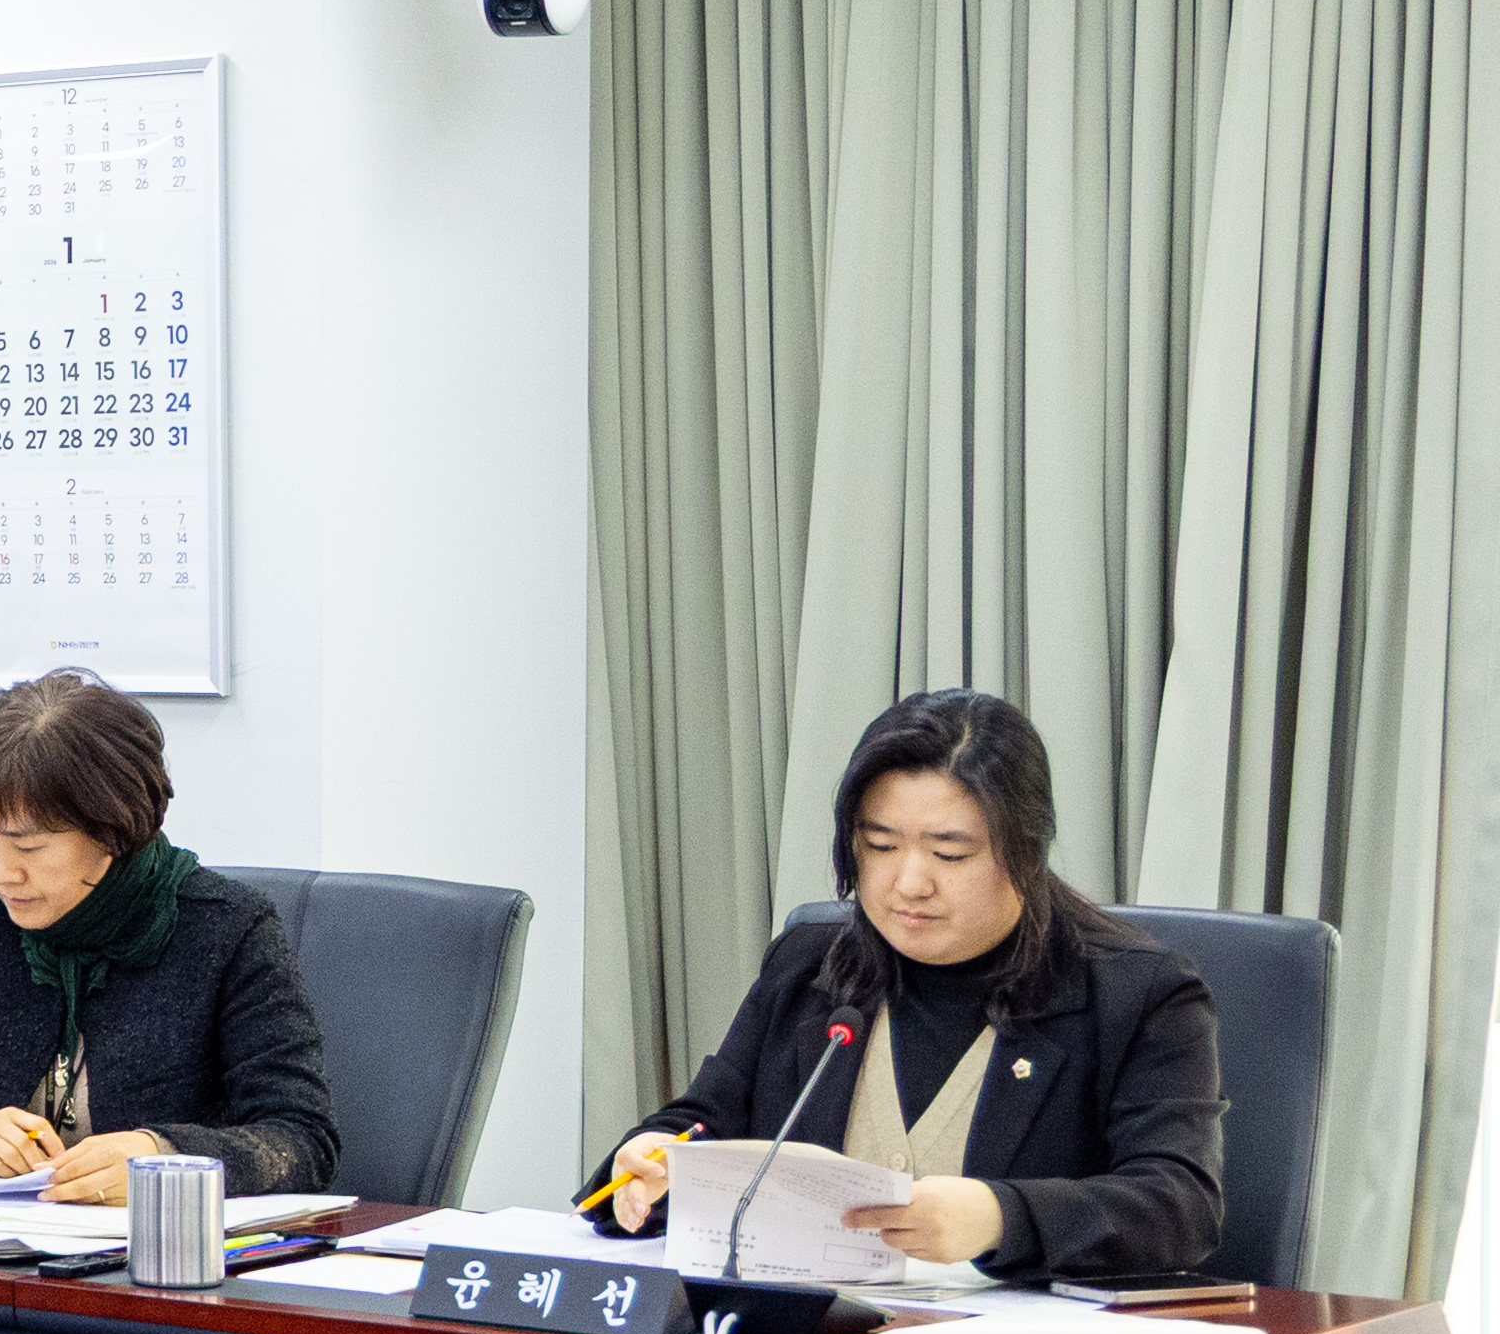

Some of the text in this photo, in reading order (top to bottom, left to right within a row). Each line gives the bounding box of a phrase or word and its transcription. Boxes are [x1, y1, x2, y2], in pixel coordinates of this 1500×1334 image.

[61, 88, 77, 105] 12
[31, 127, 39, 138] 2
[66, 124, 74, 135] 3
[101, 122, 110, 132] 4
[138, 119, 146, 131] 5
[175, 117, 183, 128] 6
[30, 146, 39, 156] 9
[65, 144, 75, 155] 10
[101, 141, 110, 152] 11
[174, 136, 184, 148] 13
[30, 166, 40, 176] 16
[65, 163, 75, 173] 17
[101, 161, 111, 172] 18
[137, 159, 147, 169] 19
[172, 156, 186, 168] 20
[29, 184, 41, 196] 23
[64, 183, 76, 194] 24
[99, 180, 112, 192] 25
[136, 178, 148, 189] 26
[173, 176, 185, 187] 27
[29, 204, 41, 215] 30
[65, 202, 74, 213] 31
[63, 236, 73, 264] 1
[100, 291, 183, 313] 1 2 3
[29, 331, 40, 349] 6
[64, 329, 74, 348] 7
[99, 328, 111, 347] 8
[135, 326, 146, 345] 9
[167, 325, 188, 344] 10
[26, 364, 44, 382] 13
[60, 363, 79, 381] 14
[95, 361, 114, 380] 15
[131, 360, 151, 379] 16
[169, 359, 187, 378] 17
[24, 397, 47, 416] 20
[61, 396, 78, 415] 21
[94, 394, 117, 414] 22
[130, 393, 153, 413] 23
[166, 393, 191, 412] 24
[26, 430, 47, 449] 27
[59, 429, 82, 448] 28
[94, 428, 117, 447] 29
[130, 427, 154, 447] 30
[169, 427, 187, 446] 31
[66, 478, 76, 495] 2
[0, 515, 8, 527] 2
[34, 515, 42, 526] 3
[69, 515, 77, 525] 4
[104, 514, 113, 525] 5
[140, 515, 149, 525] 6
[178, 513, 186, 524] 7
[0, 535, 8, 545] 9
[34, 534, 44, 545] 10
[69, 534, 77, 545] 11
[104, 534, 114, 545] 12
[140, 533, 150, 545] 13
[177, 533, 187, 543] 14
[0, 554, 10, 565] 16
[34, 554, 43, 564] 17
[69, 553, 79, 564] 18
[105, 553, 114, 563] 19
[139, 553, 152, 564] 20
[177, 552, 187, 563] 21
[0, 573, 11, 584] 23
[33, 573, 45, 584] 24
[68, 573, 80, 584] 25
[104, 573, 116, 583] 26
[140, 572, 152, 583] 27
[176, 572, 188, 583] 28
